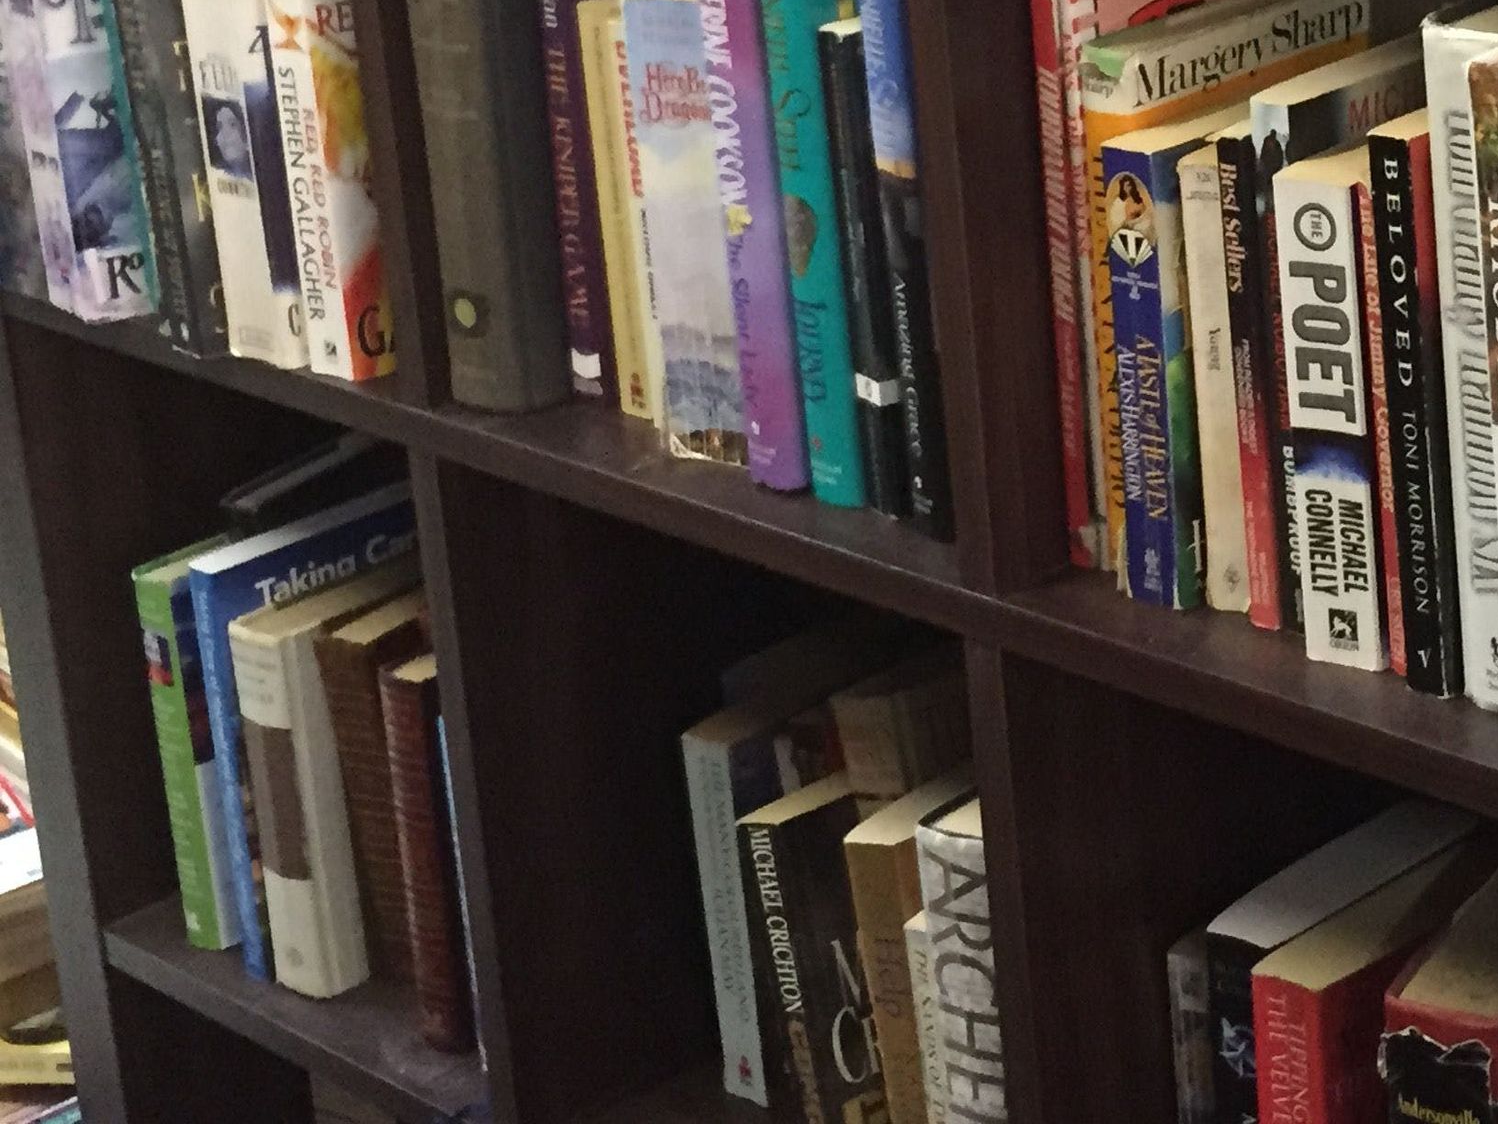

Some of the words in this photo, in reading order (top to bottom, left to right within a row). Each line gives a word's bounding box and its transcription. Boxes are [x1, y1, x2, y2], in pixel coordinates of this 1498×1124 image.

[1132, 34, 1263, 108] Margery
[1271, 0, 1364, 56] Sharp
[310, 161, 327, 209] RED
[706, 74, 748, 206] COOKSON
[1219, 162, 1240, 212] Best
[277, 65, 302, 169] STEPHEN
[292, 174, 327, 322] GALLAGHER
[1308, 212, 1323, 239] THE
[317, 213, 338, 291] ROBIN
[1224, 217, 1249, 294] Sellers
[1383, 157, 1415, 388] BELOVED
[1289, 259, 1358, 425] POET
[1121, 405, 1144, 502] HARRINGTON
[1401, 410, 1420, 471] TONI
[255, 551, 358, 608] Taking
[1304, 487, 1339, 598] CONNELLY
[1337, 497, 1369, 594] MICHAEL
[1406, 481, 1430, 615] MORRISON
[747, 827, 783, 914] MICHAEL
[763, 909, 803, 1015] CRICHTON
